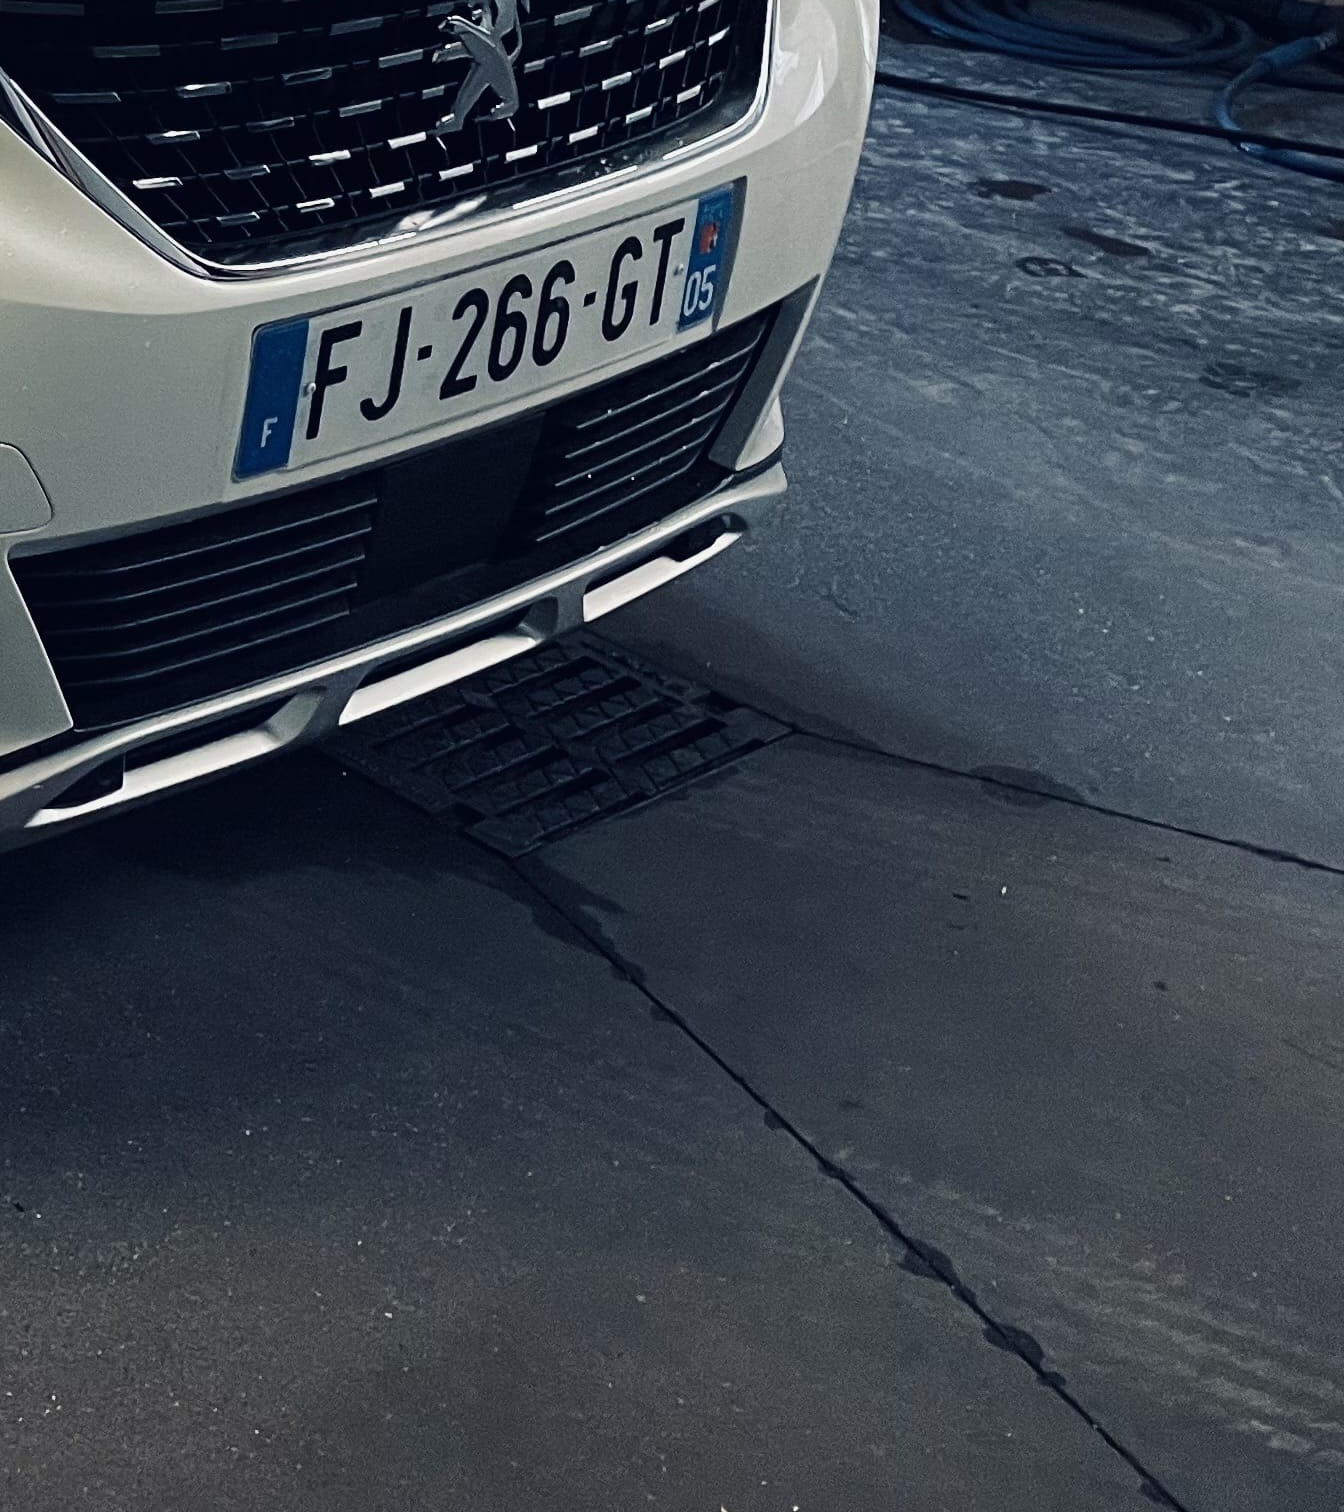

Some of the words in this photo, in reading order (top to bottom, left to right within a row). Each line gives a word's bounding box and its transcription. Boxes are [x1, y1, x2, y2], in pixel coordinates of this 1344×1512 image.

[259, 416, 279, 448] F
[305, 217, 686, 440] FJ-266-GT
[683, 264, 716, 317] 05
